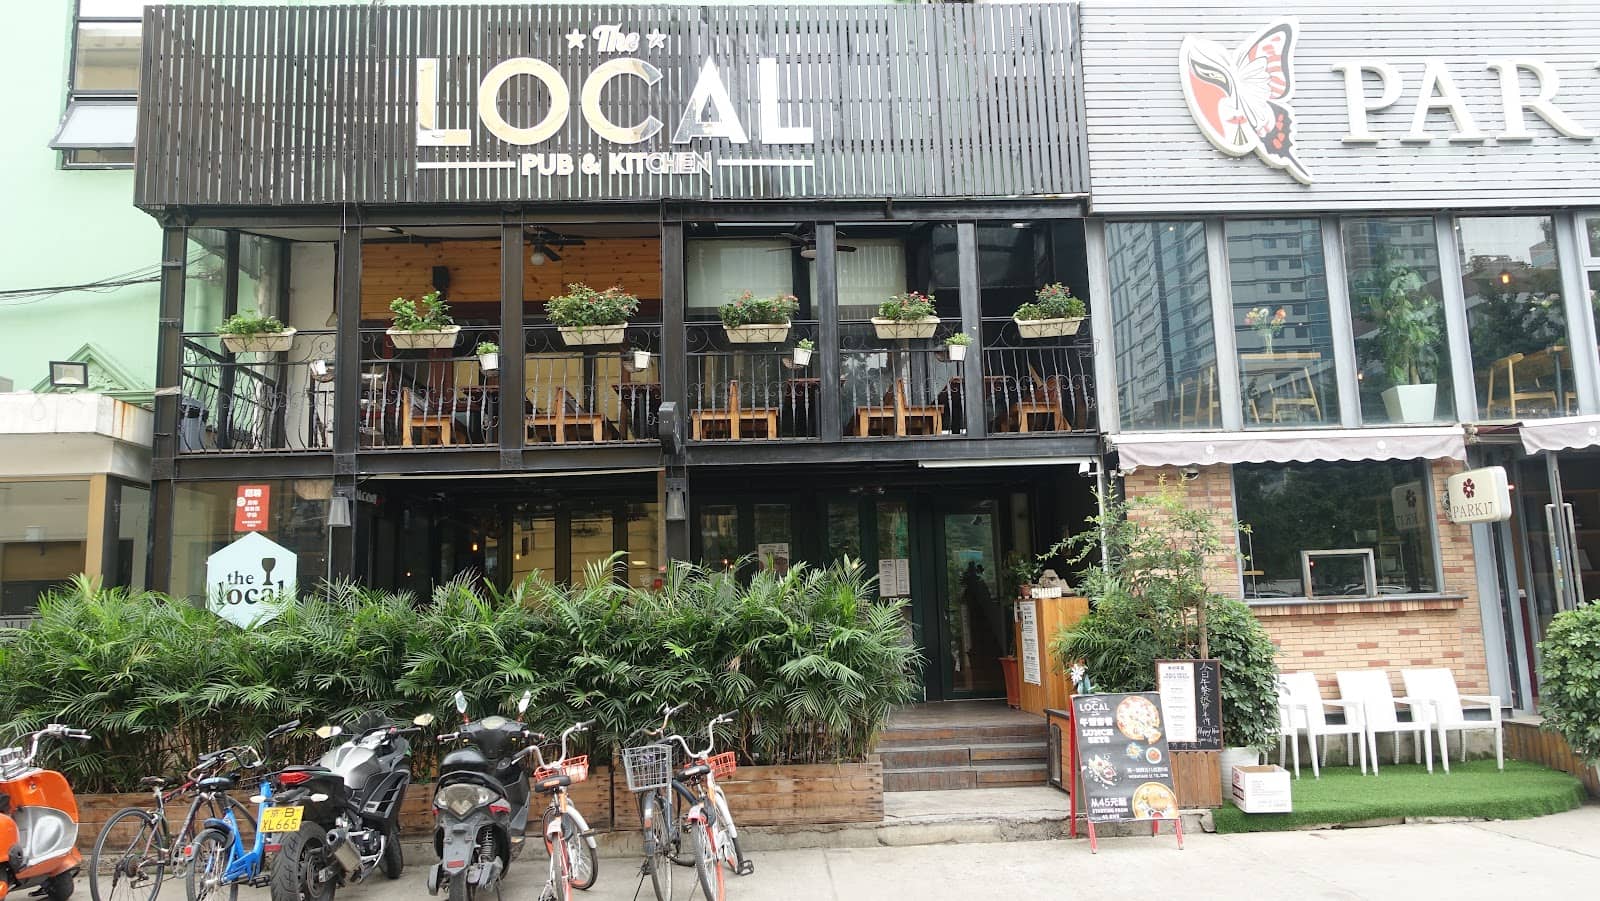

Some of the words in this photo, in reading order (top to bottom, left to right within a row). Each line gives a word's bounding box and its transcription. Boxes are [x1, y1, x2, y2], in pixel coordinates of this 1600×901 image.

[592, 24, 640, 54] The
[416, 55, 814, 147] LOCAL
[1330, 57, 1600, 144] PAR
[521, 152, 573, 176] PUB
[581, 153, 600, 175] &
[609, 151, 712, 177] KITCHEN
[1451, 501, 1494, 519] PARK17
[227, 570, 254, 585] the
[216, 579, 284, 606] local
[1079, 702, 1110, 711] LOCAL
[262, 818, 298, 831] XL665
